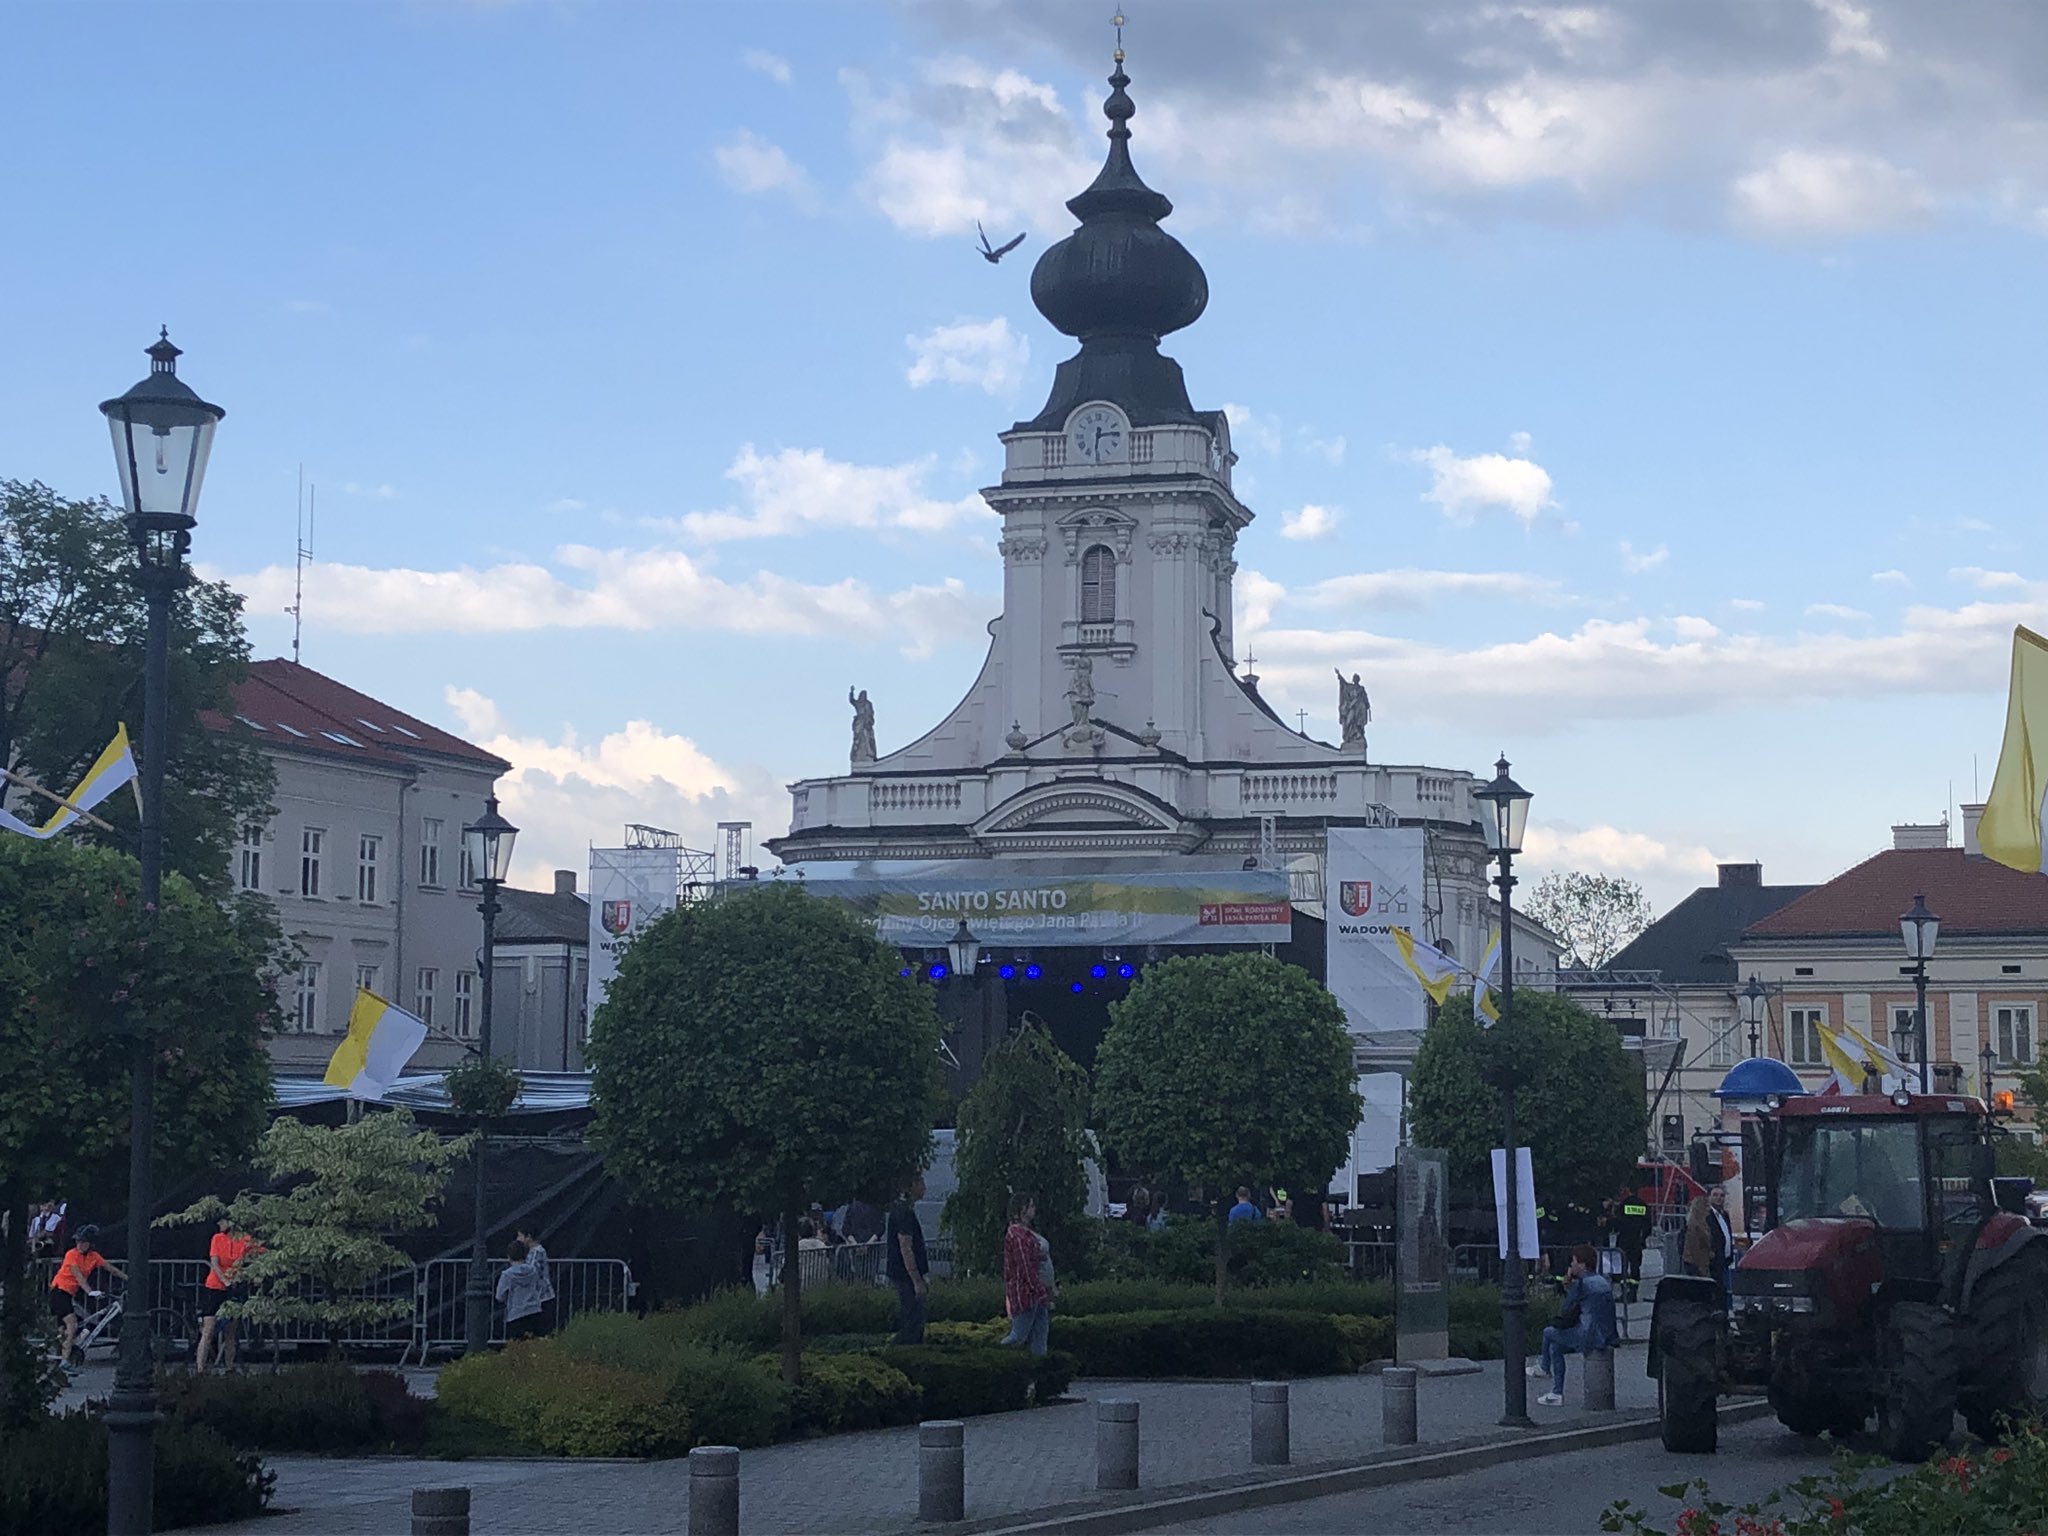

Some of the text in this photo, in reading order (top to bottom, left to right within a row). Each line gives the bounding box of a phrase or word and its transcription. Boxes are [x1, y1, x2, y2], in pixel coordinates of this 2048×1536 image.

[918, 890, 1067, 911] SANTO SANTO
[920, 914, 954, 931] Ojca
[1039, 913, 1075, 928] Jana
[1339, 925, 1411, 935] WADOWE
